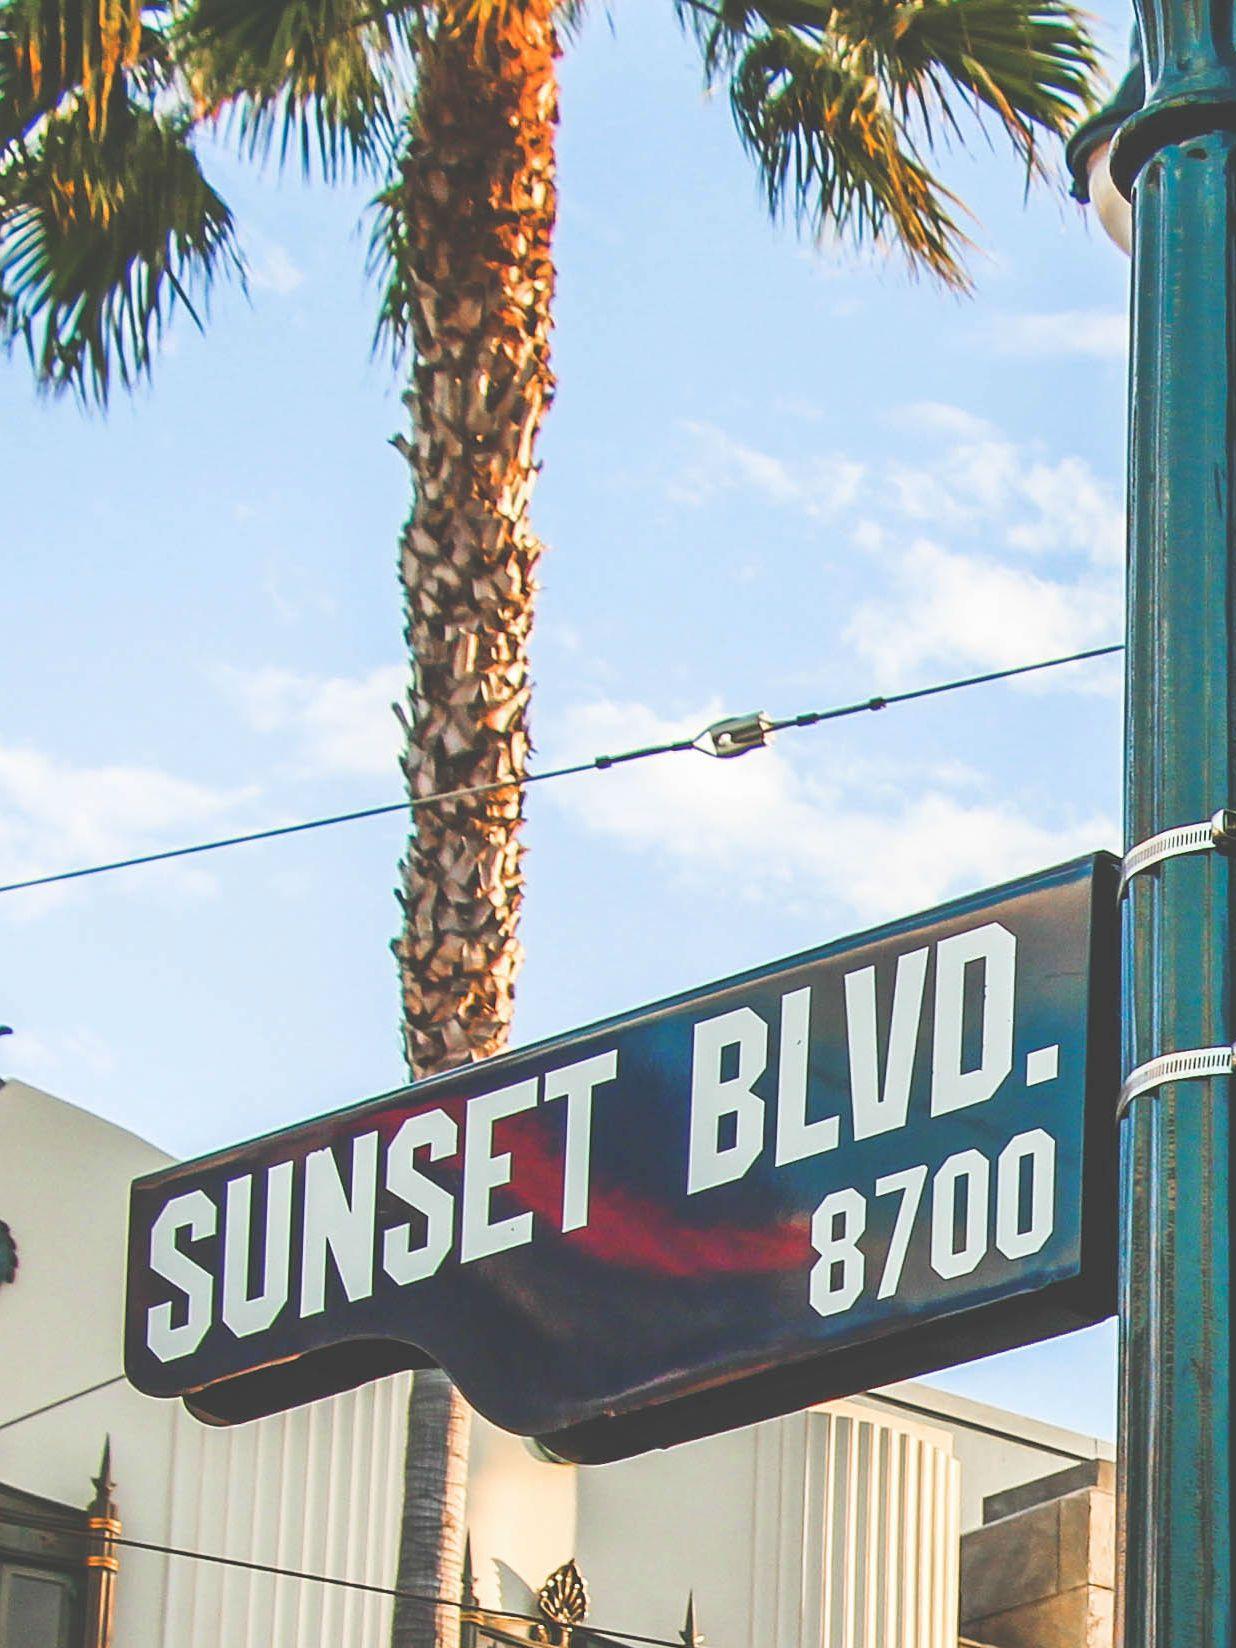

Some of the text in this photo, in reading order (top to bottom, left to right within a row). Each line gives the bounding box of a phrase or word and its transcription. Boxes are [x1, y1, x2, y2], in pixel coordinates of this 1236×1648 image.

[147, 922, 1059, 1363] SUNSET BLVD.
[809, 1128, 1056, 1317] 8700
